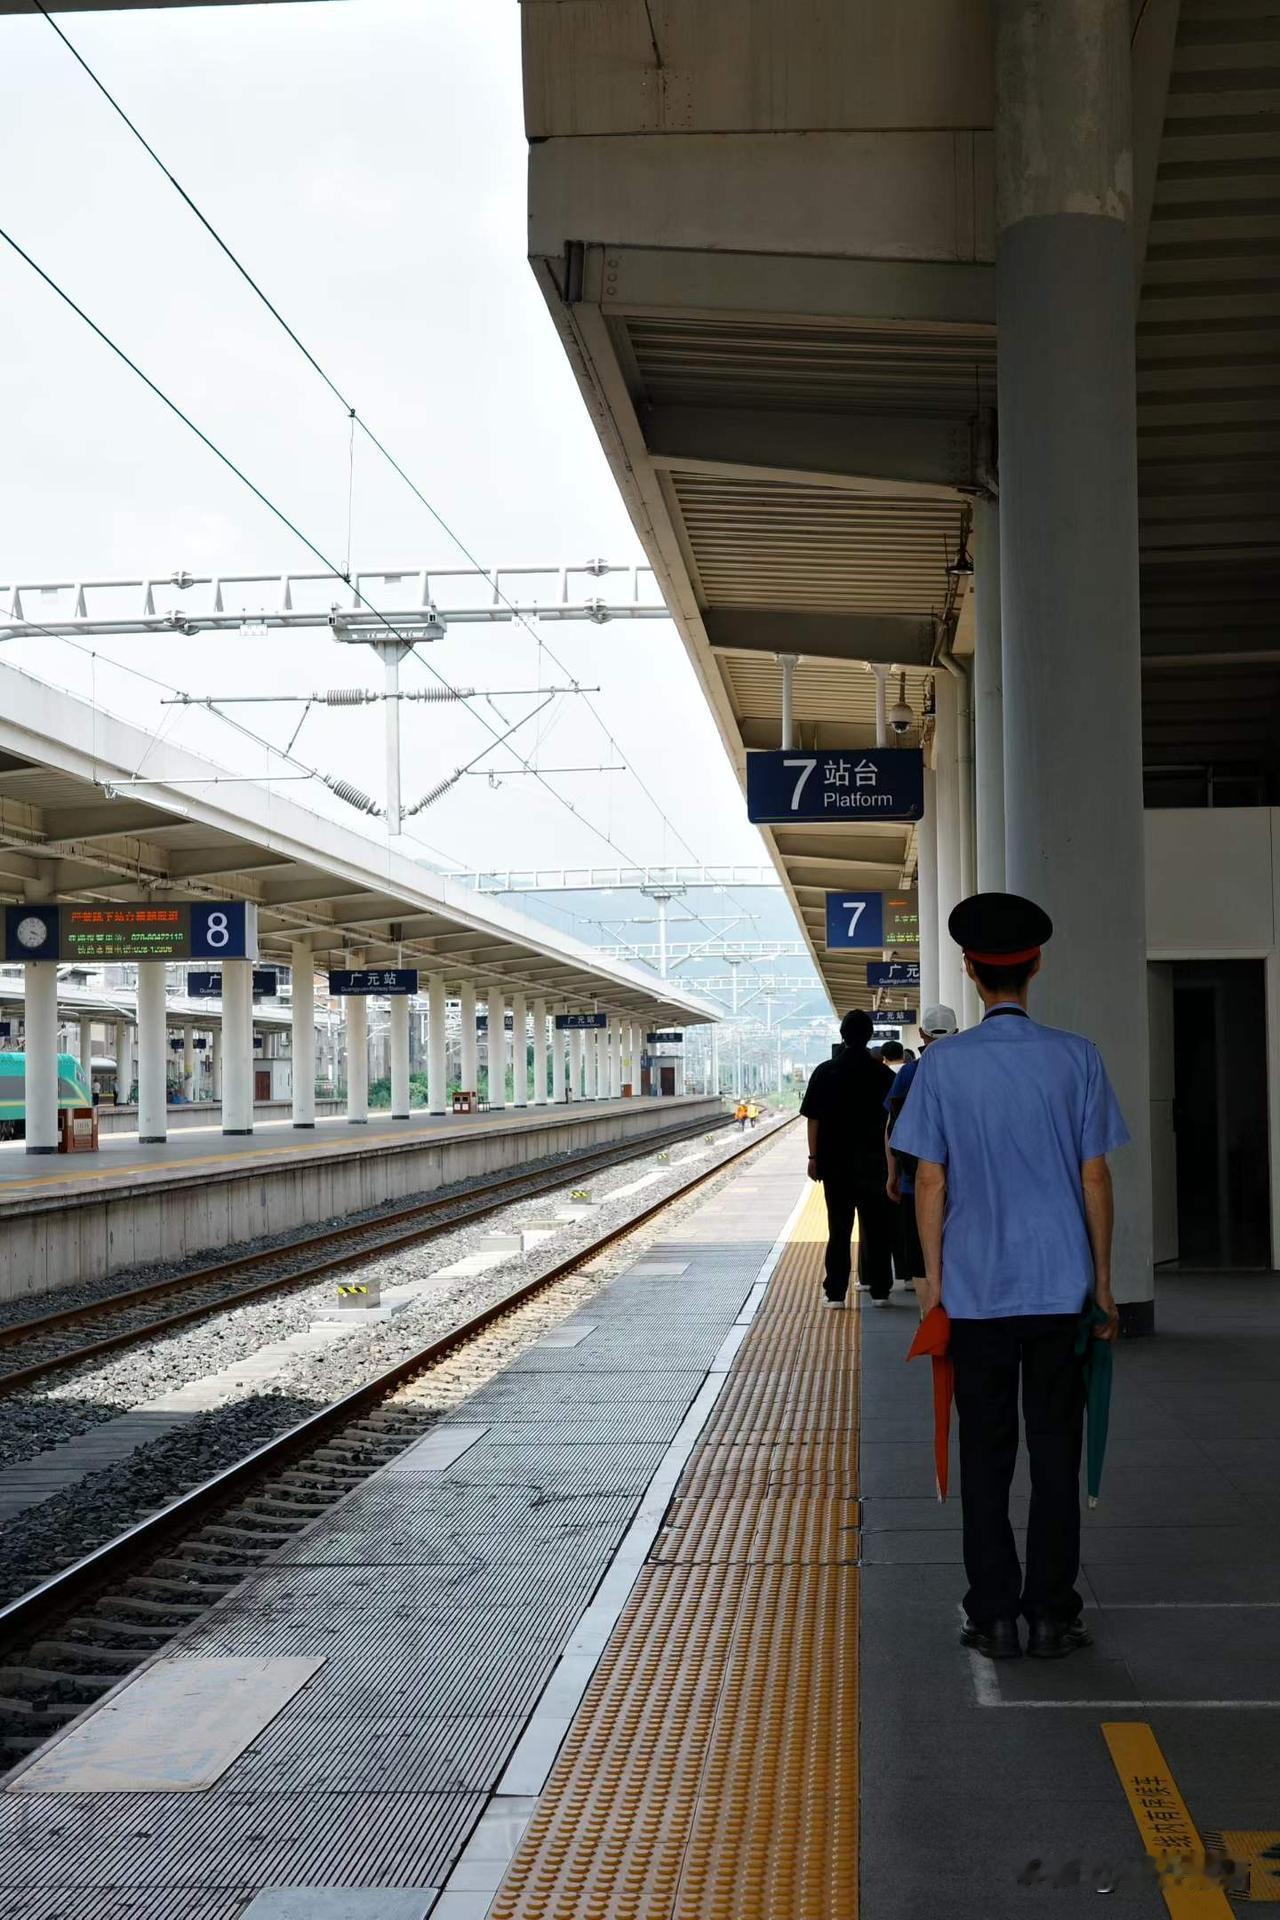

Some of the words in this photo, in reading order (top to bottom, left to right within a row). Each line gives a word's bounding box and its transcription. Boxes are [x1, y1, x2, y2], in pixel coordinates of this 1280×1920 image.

[823, 759, 879, 787] 站台
[783, 758, 818, 811] 7
[823, 792, 893, 807] Platform
[206, 911, 229, 947] 8
[842, 901, 866, 937] 7
[350, 972, 397, 986] 广元站
[567, 1016, 595, 1024] 广元站
[876, 1011, 905, 1020] 广元站
